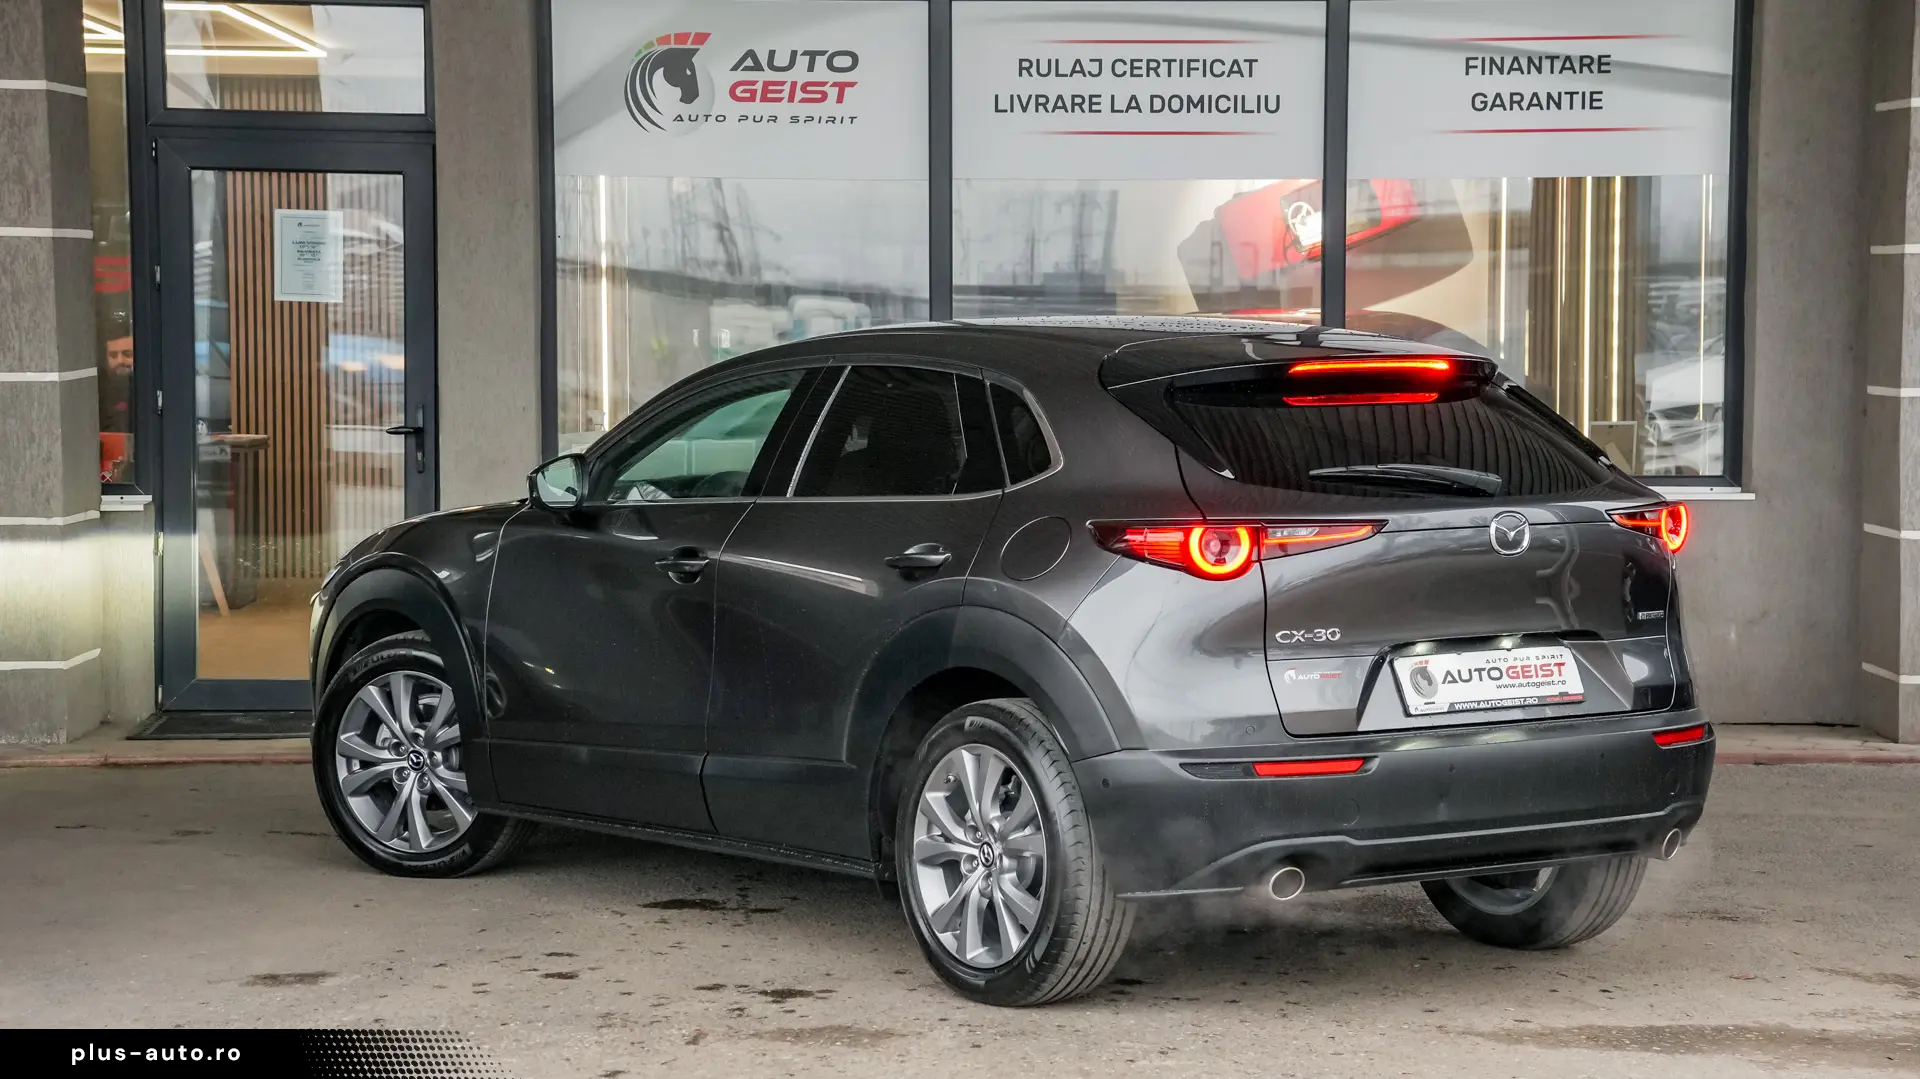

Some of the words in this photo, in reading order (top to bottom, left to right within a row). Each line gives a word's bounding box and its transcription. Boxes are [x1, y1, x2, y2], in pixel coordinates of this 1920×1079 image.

[729, 48, 860, 74] AUTO
[1018, 58, 1103, 78] RULAJ
[1110, 58, 1259, 79] CERTIFICAT
[1465, 54, 1612, 76] FINANTARE
[728, 79, 859, 105] GEIST
[1471, 90, 1604, 112] GARANTIE
[994, 93, 1102, 114] LIVRARE
[1110, 94, 1143, 114] LA
[1149, 93, 1281, 115] DOMICILIU
[672, 113, 727, 123] AUTO
[737, 114, 779, 124] PUR
[789, 115, 859, 125] SPIRIT
[1275, 627, 1342, 644] CX-30
[1485, 656, 1509, 664] AUTO
[1535, 653, 1564, 661] SPIRIT
[1495, 679, 1567, 691] www.autogeist.ro
[1454, 697, 1538, 709] WWW.AUTOGEIST.RO
